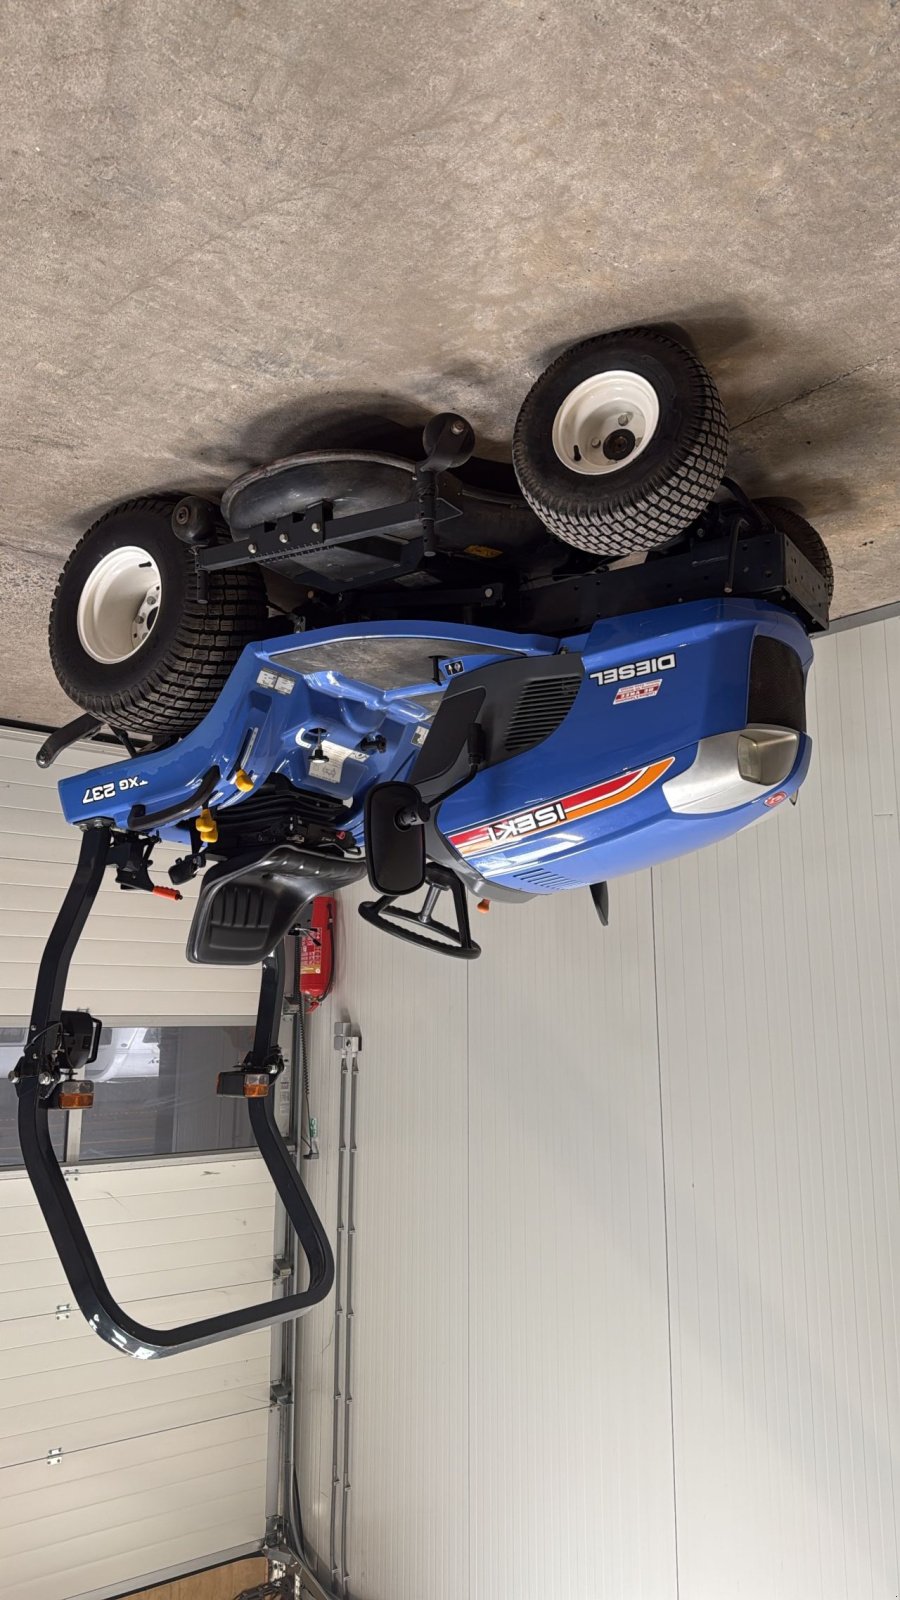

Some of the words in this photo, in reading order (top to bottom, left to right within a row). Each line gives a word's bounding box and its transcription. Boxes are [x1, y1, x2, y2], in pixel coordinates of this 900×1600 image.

[589, 653, 676, 686] DIESEL
[82, 782, 116, 804] 237
[487, 803, 566, 842] ISEKI
